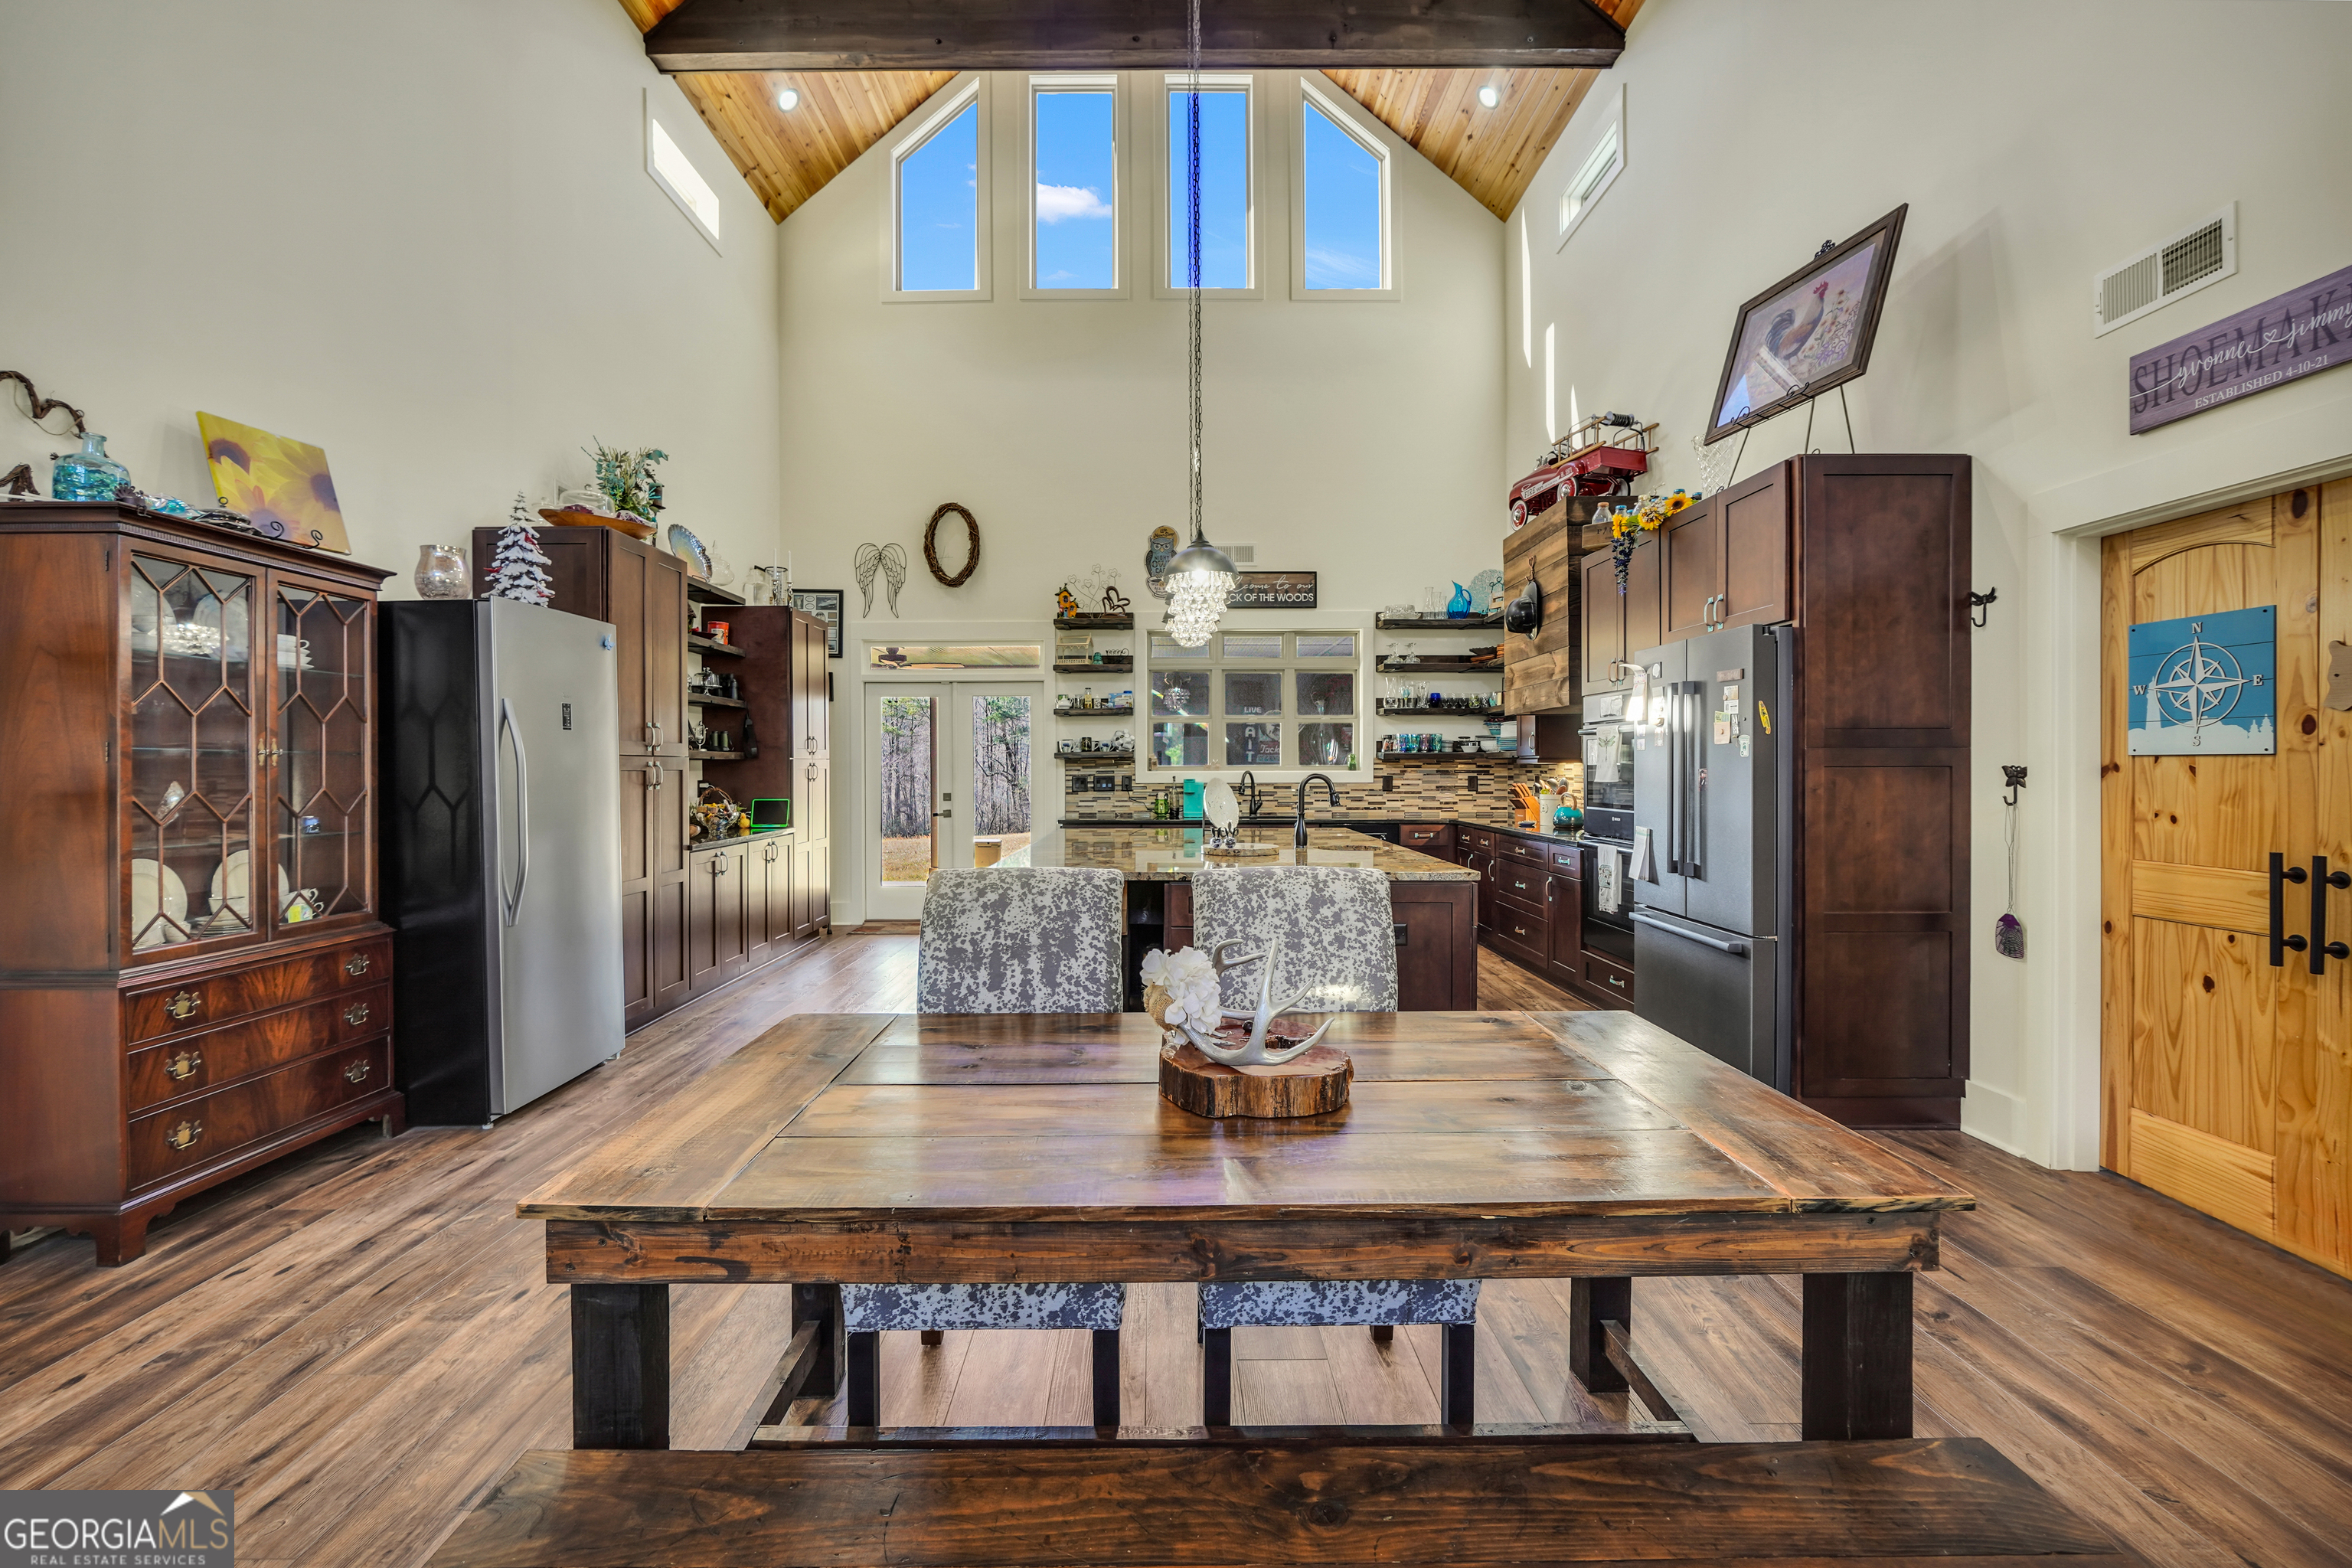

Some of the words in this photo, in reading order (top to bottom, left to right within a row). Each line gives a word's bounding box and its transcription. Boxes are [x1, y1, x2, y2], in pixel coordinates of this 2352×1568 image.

[2177, 341, 2252, 389] yvonne
[2194, 371, 2282, 410] ESTABLISHED
[2286, 354, 2329, 377] 4-10-21
[1524, 486, 1536, 498] FIRE
[1272, 574, 1292, 590] to
[1228, 593, 1243, 602] CK
[1243, 593, 1257, 602] OF
[1258, 593, 1276, 602] THE
[1276, 593, 1314, 602] WOODS
[2191, 622, 2203, 635] N
[2252, 674, 2264, 687] E
[2132, 684, 2148, 696] W
[1245, 717, 1256, 762] AIT
[2192, 735, 2201, 747] S
[1259, 744, 1280, 753] Tack
